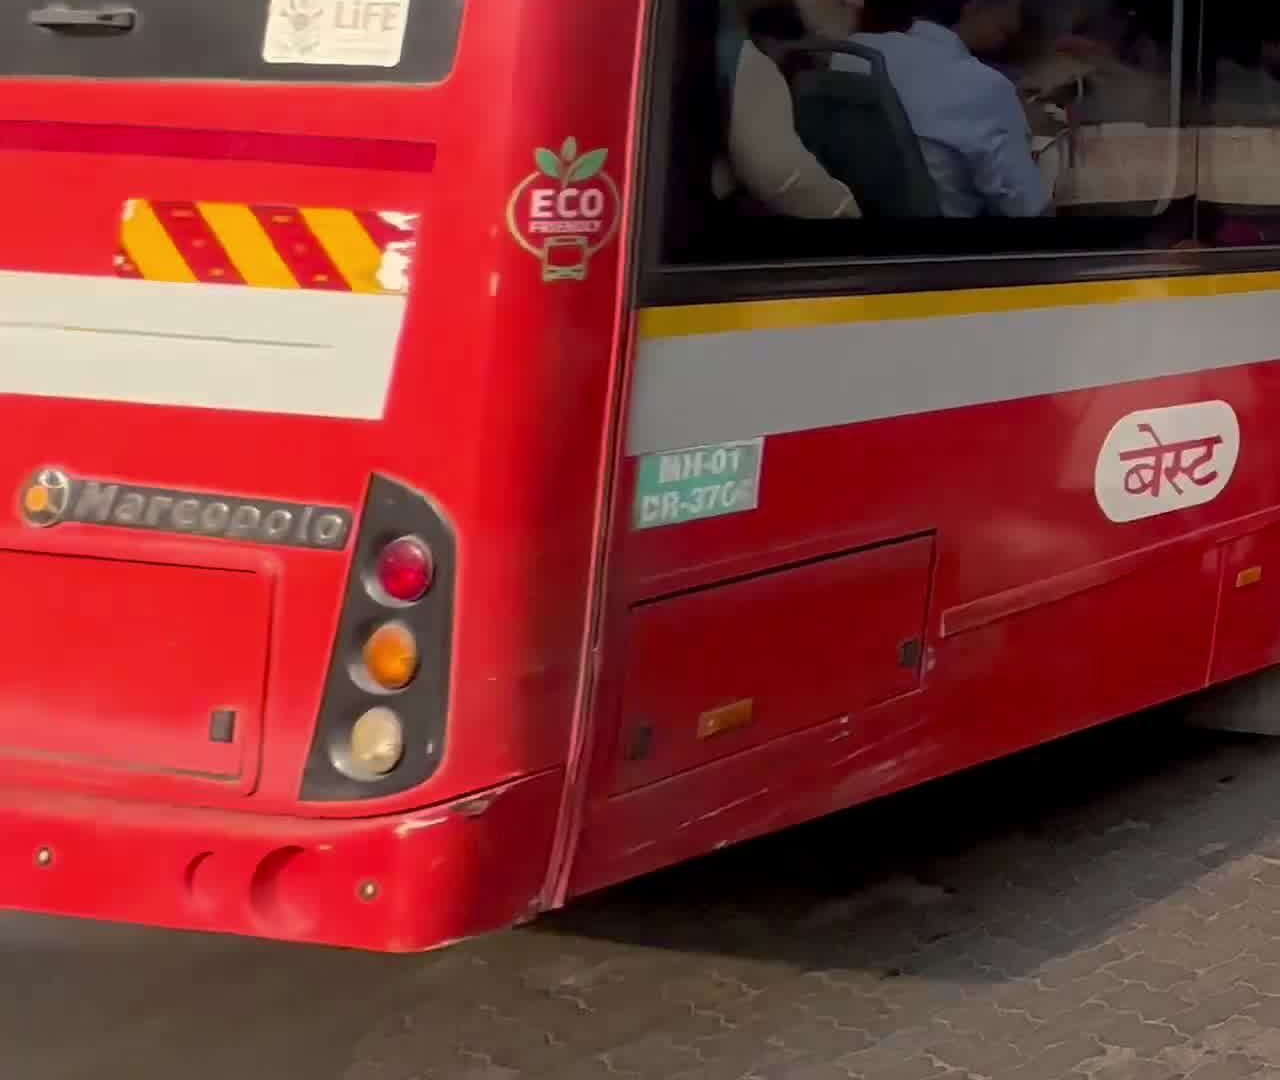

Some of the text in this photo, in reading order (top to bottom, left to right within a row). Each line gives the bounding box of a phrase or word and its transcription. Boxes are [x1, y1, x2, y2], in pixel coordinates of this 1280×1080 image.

[529, 187, 604, 219] ECO
[656, 448, 742, 483] MH-01
[1118, 423, 1223, 498] बेस्ट
[73, 480, 345, 545] Marcopolo
